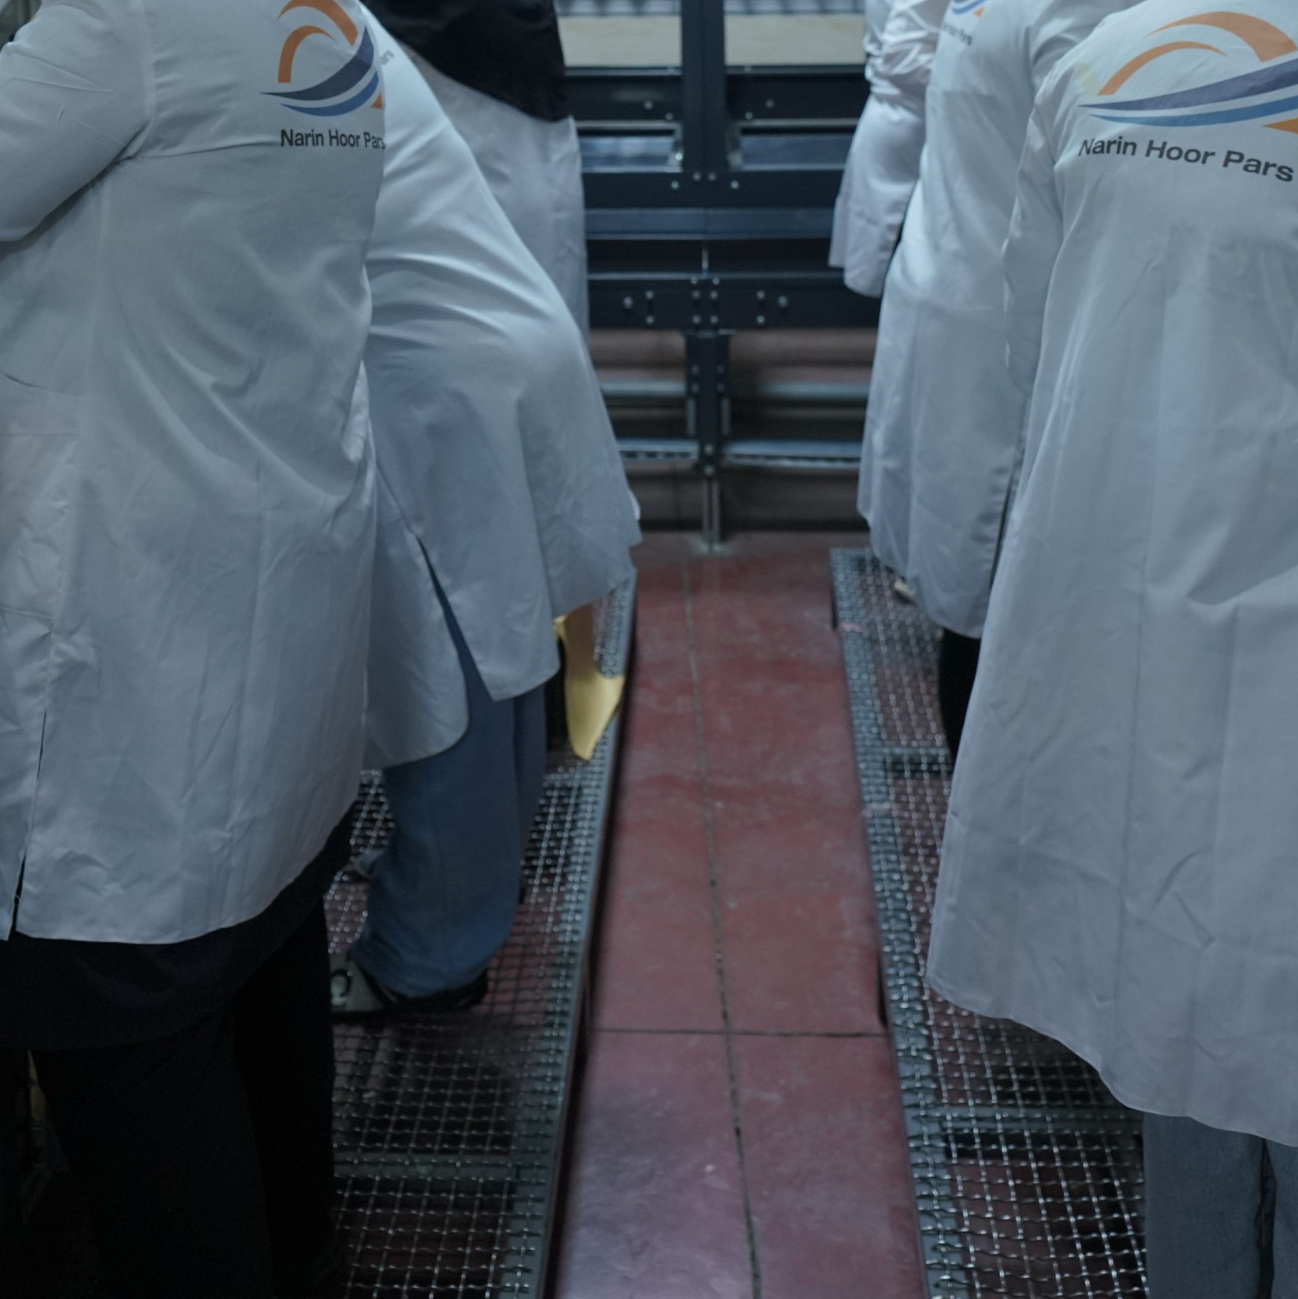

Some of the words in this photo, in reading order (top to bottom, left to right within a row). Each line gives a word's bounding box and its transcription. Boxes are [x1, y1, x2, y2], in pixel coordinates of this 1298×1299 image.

[280, 129, 324, 147] Narin
[328, 130, 361, 147] Hoor
[364, 132, 386, 150] Pars
[1078, 135, 1138, 157] Narin
[1145, 140, 1216, 165] Hoor
[1222, 150, 1295, 182] Pars
